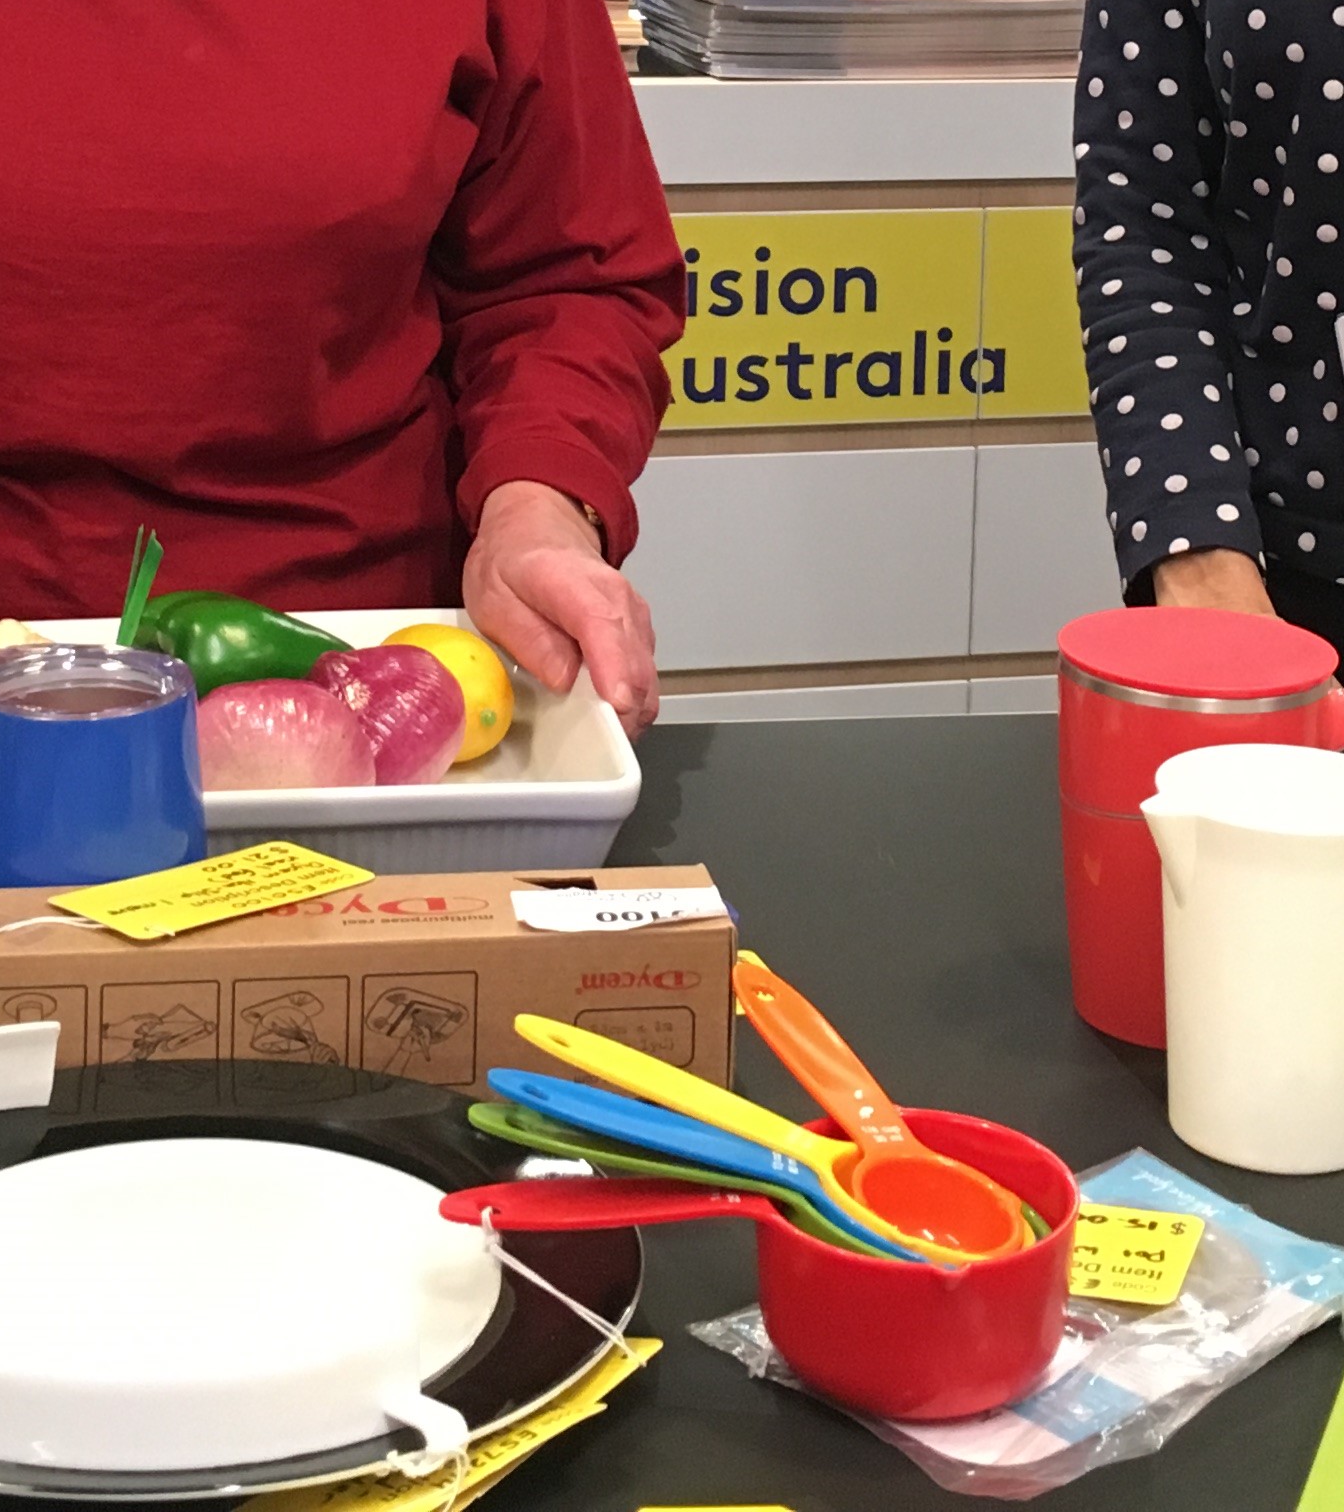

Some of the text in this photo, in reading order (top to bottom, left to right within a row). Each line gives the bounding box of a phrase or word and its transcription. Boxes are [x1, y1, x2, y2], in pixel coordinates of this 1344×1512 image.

[684, 246, 877, 318] ision
[672, 327, 1006, 403] ustralia
[191, 867, 340, 908] Item Description
[1111, 1265, 1163, 1280] Item
[1112, 1281, 1158, 1294] Code
